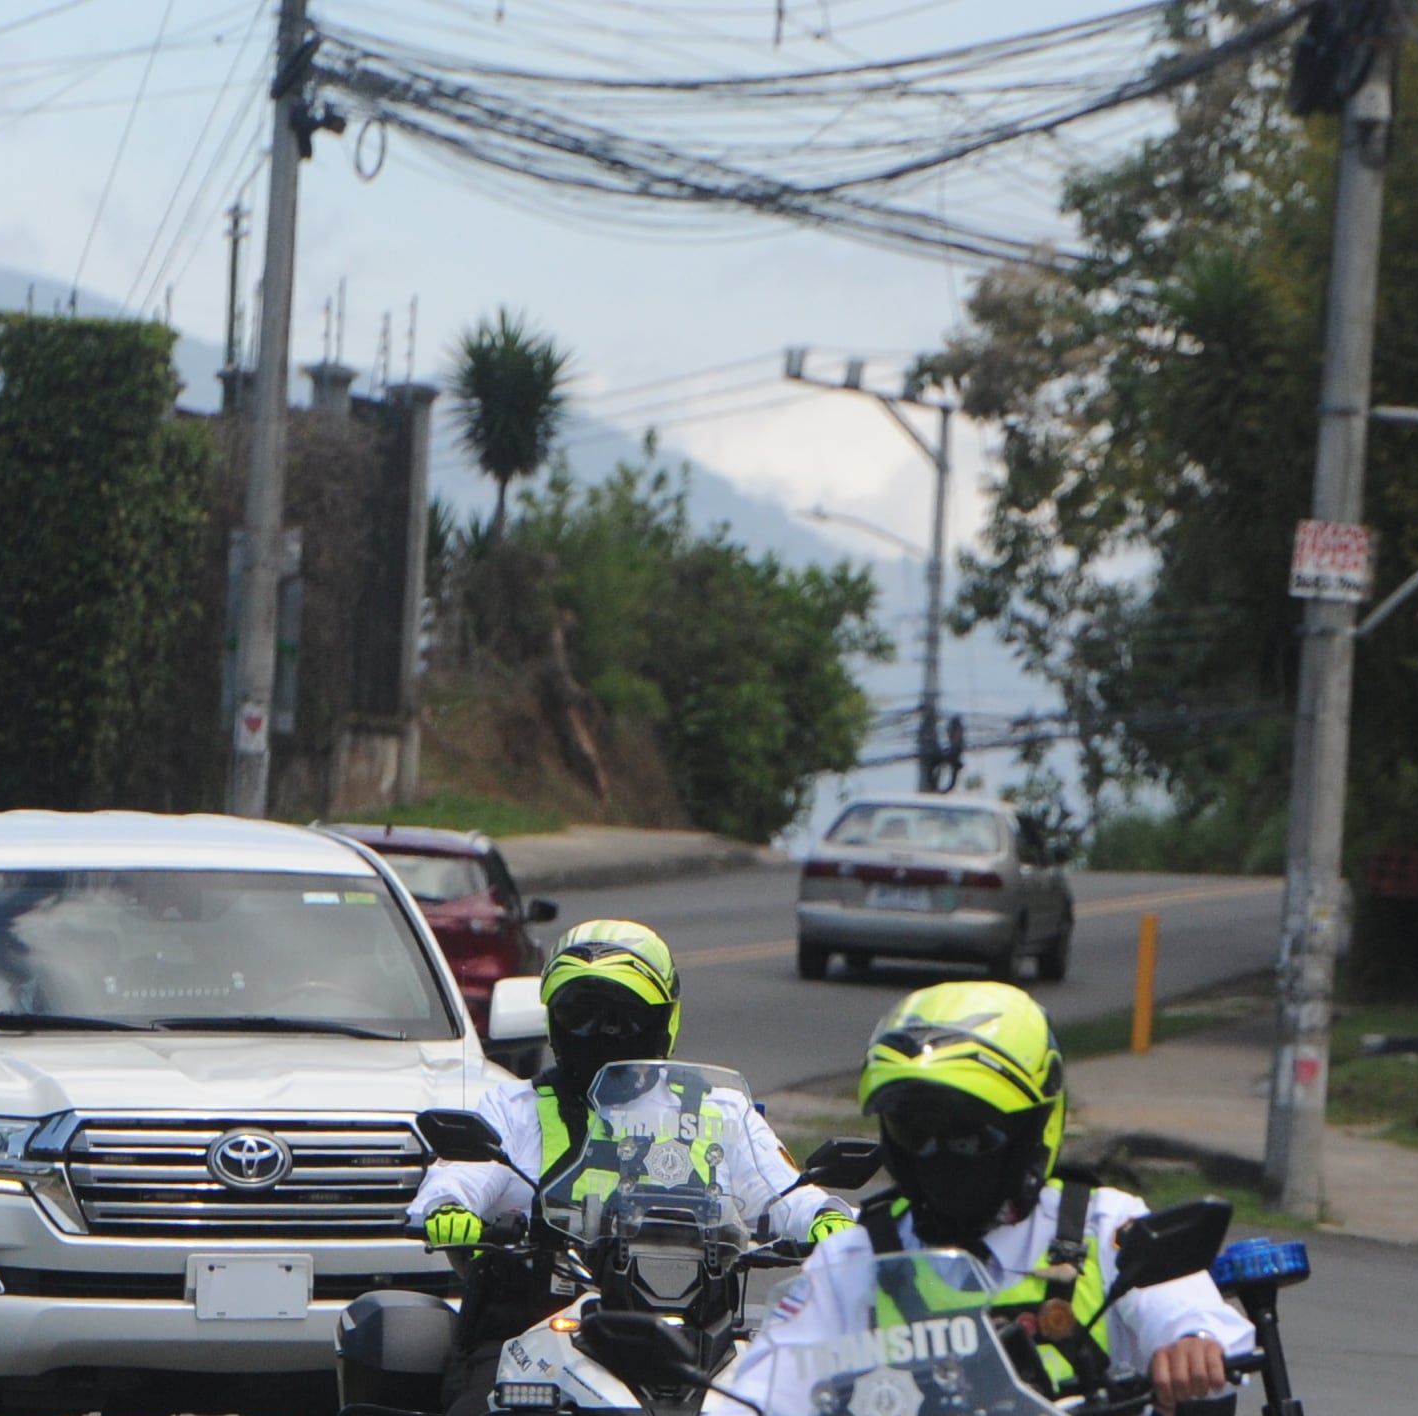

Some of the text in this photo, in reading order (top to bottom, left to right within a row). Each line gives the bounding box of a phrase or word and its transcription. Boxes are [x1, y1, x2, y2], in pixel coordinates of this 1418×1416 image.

[609, 1109, 740, 1145] TRANSITO
[507, 1339, 533, 1373] SUZUKI
[790, 1315, 979, 1381] TRANSITO
